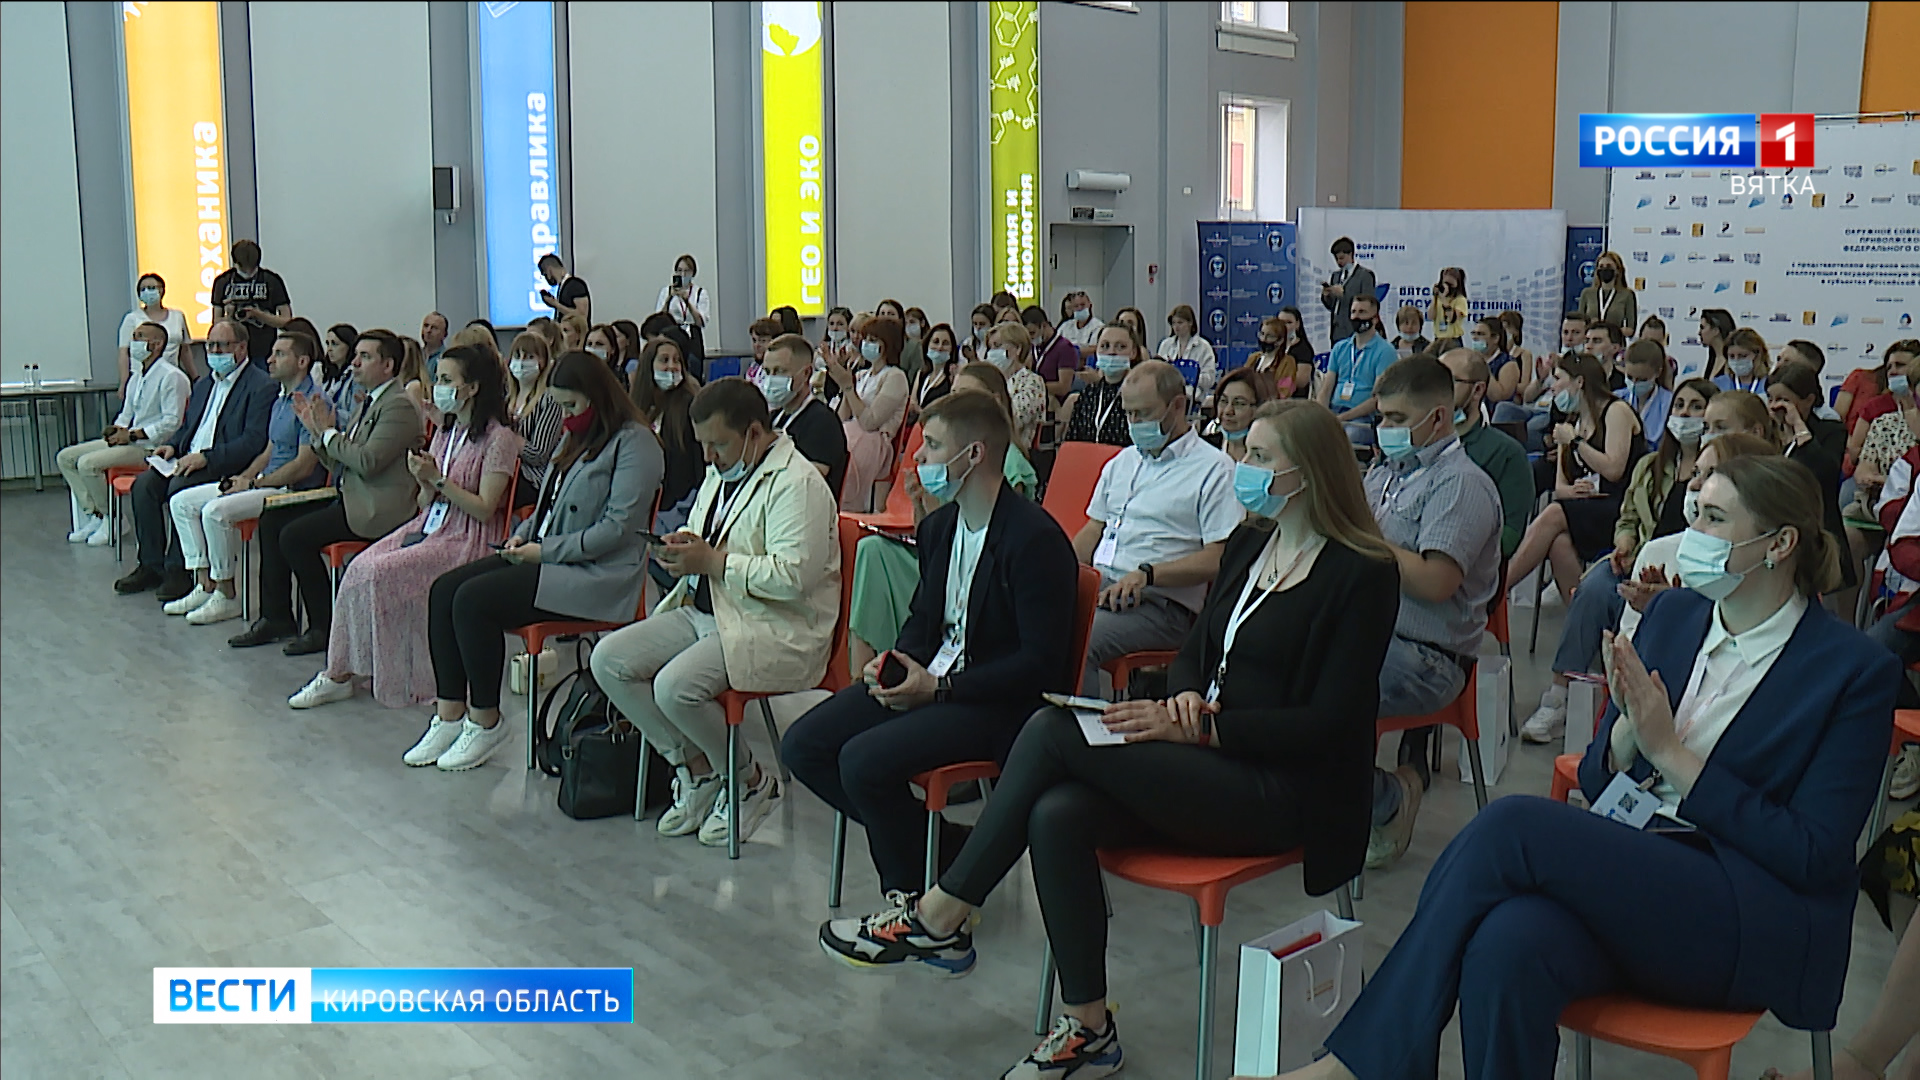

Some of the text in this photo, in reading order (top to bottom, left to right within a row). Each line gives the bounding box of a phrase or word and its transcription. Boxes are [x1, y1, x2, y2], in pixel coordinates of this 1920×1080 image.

[193, 121, 224, 324] Механика
[527, 91, 557, 312] Гидравлика
[799, 135, 822, 305] ГЕО И ЭКО
